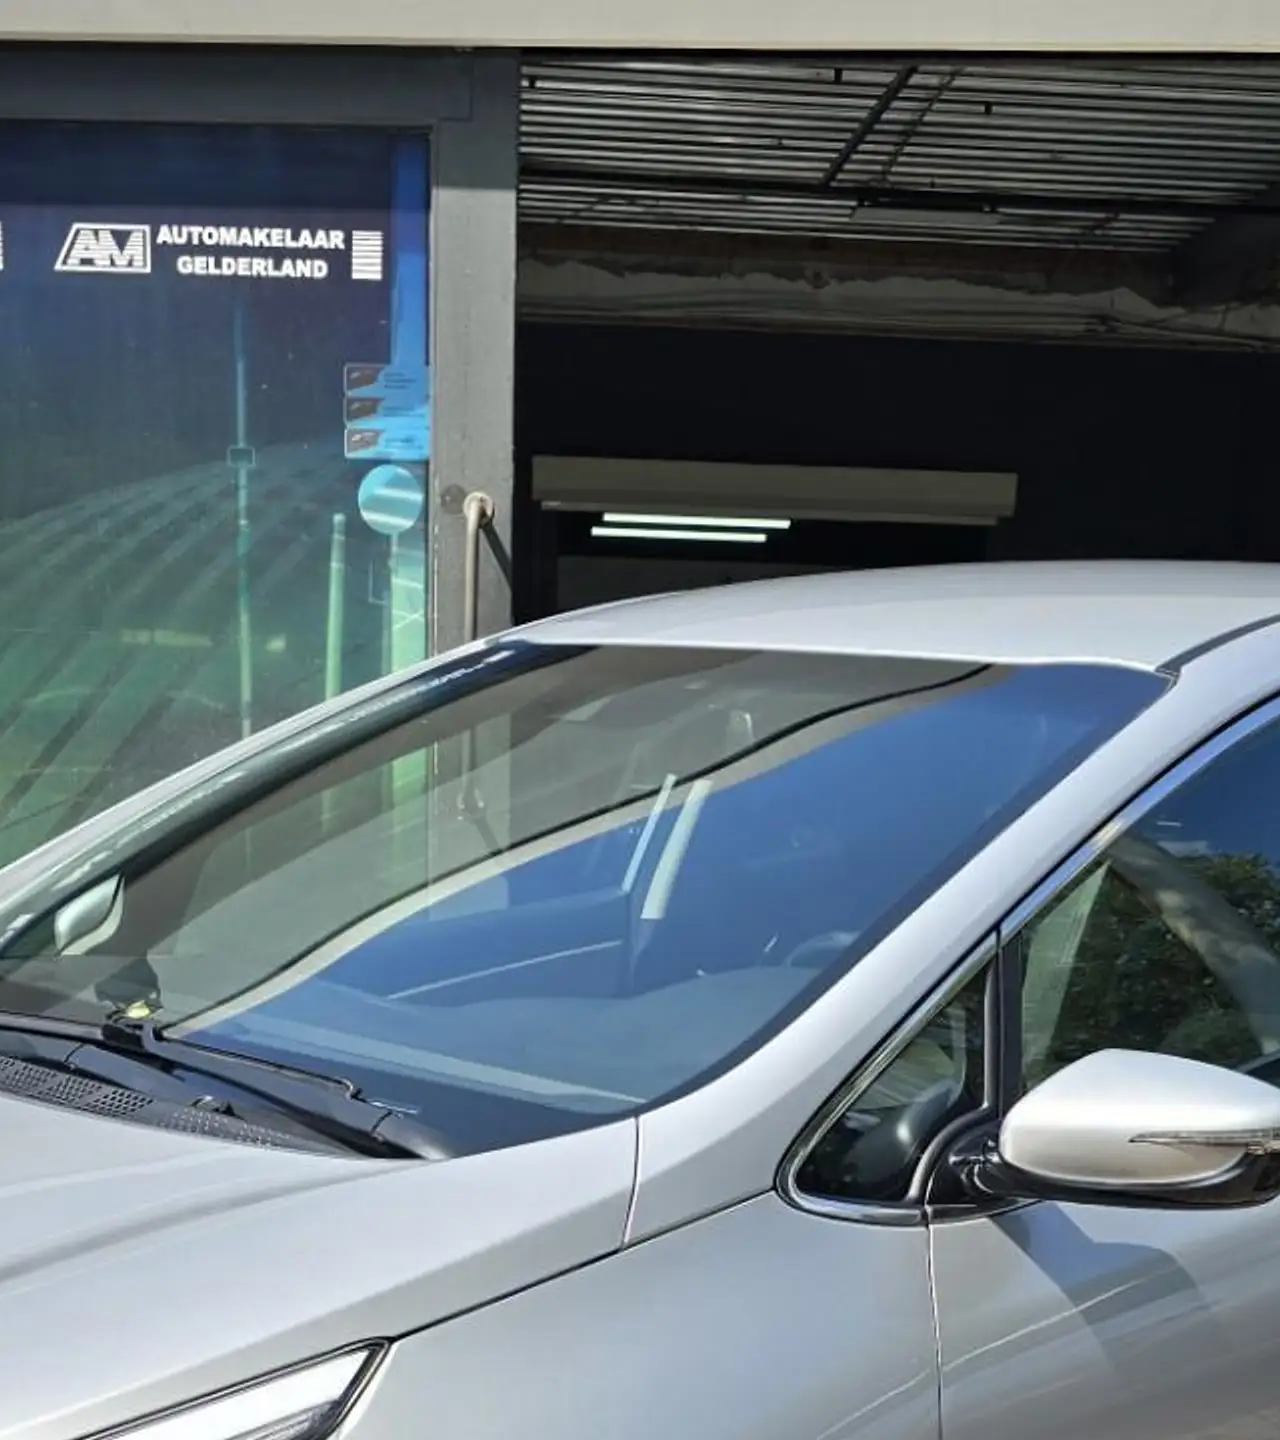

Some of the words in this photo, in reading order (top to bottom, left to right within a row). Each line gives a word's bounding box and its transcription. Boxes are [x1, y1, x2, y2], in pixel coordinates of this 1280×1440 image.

[65, 228, 145, 267] AM
[155, 223, 346, 250] AUTOMAKELAAR
[175, 254, 329, 280] GELDERLAND
